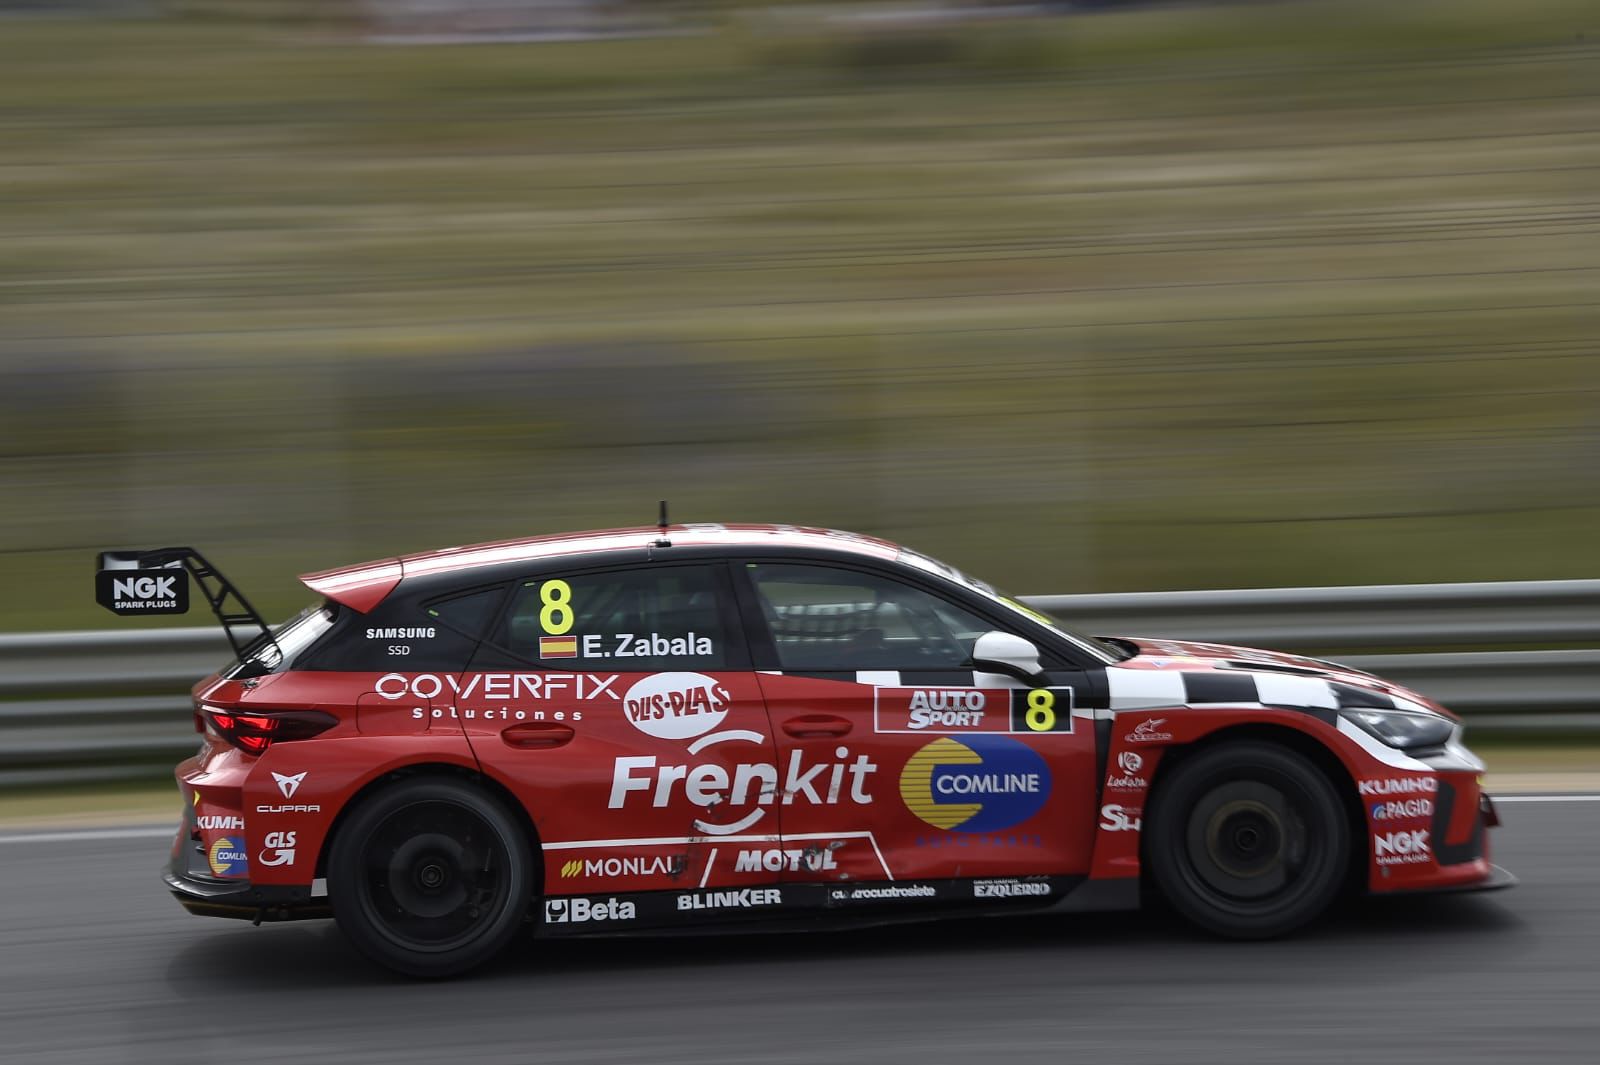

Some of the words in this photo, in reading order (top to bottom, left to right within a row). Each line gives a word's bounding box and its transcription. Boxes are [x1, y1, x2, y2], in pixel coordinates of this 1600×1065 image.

[113, 576, 176, 599] NGK
[146, 600, 176, 608] PLUGS
[539, 579, 574, 635] 8
[366, 627, 436, 639] SAMSUNG
[388, 645, 410, 656] SSD
[375, 673, 621, 700] COVERFIX
[909, 690, 985, 711] AUTO
[1025, 688, 1056, 732] 8
[412, 707, 583, 721] Soluciones
[907, 708, 985, 730] SPORT
[608, 747, 877, 808] Frenkit
[937, 774, 1040, 794] COMLINE
[1358, 776, 1438, 795] KUMHO
[256, 805, 321, 813] CUPRA
[1386, 798, 1434, 818] PAGID
[264, 832, 297, 849] GLS
[1375, 829, 1431, 856] NGK
[735, 848, 837, 872] MOTUL
[571, 898, 636, 922] Beta
[677, 889, 781, 910] BLINKER
